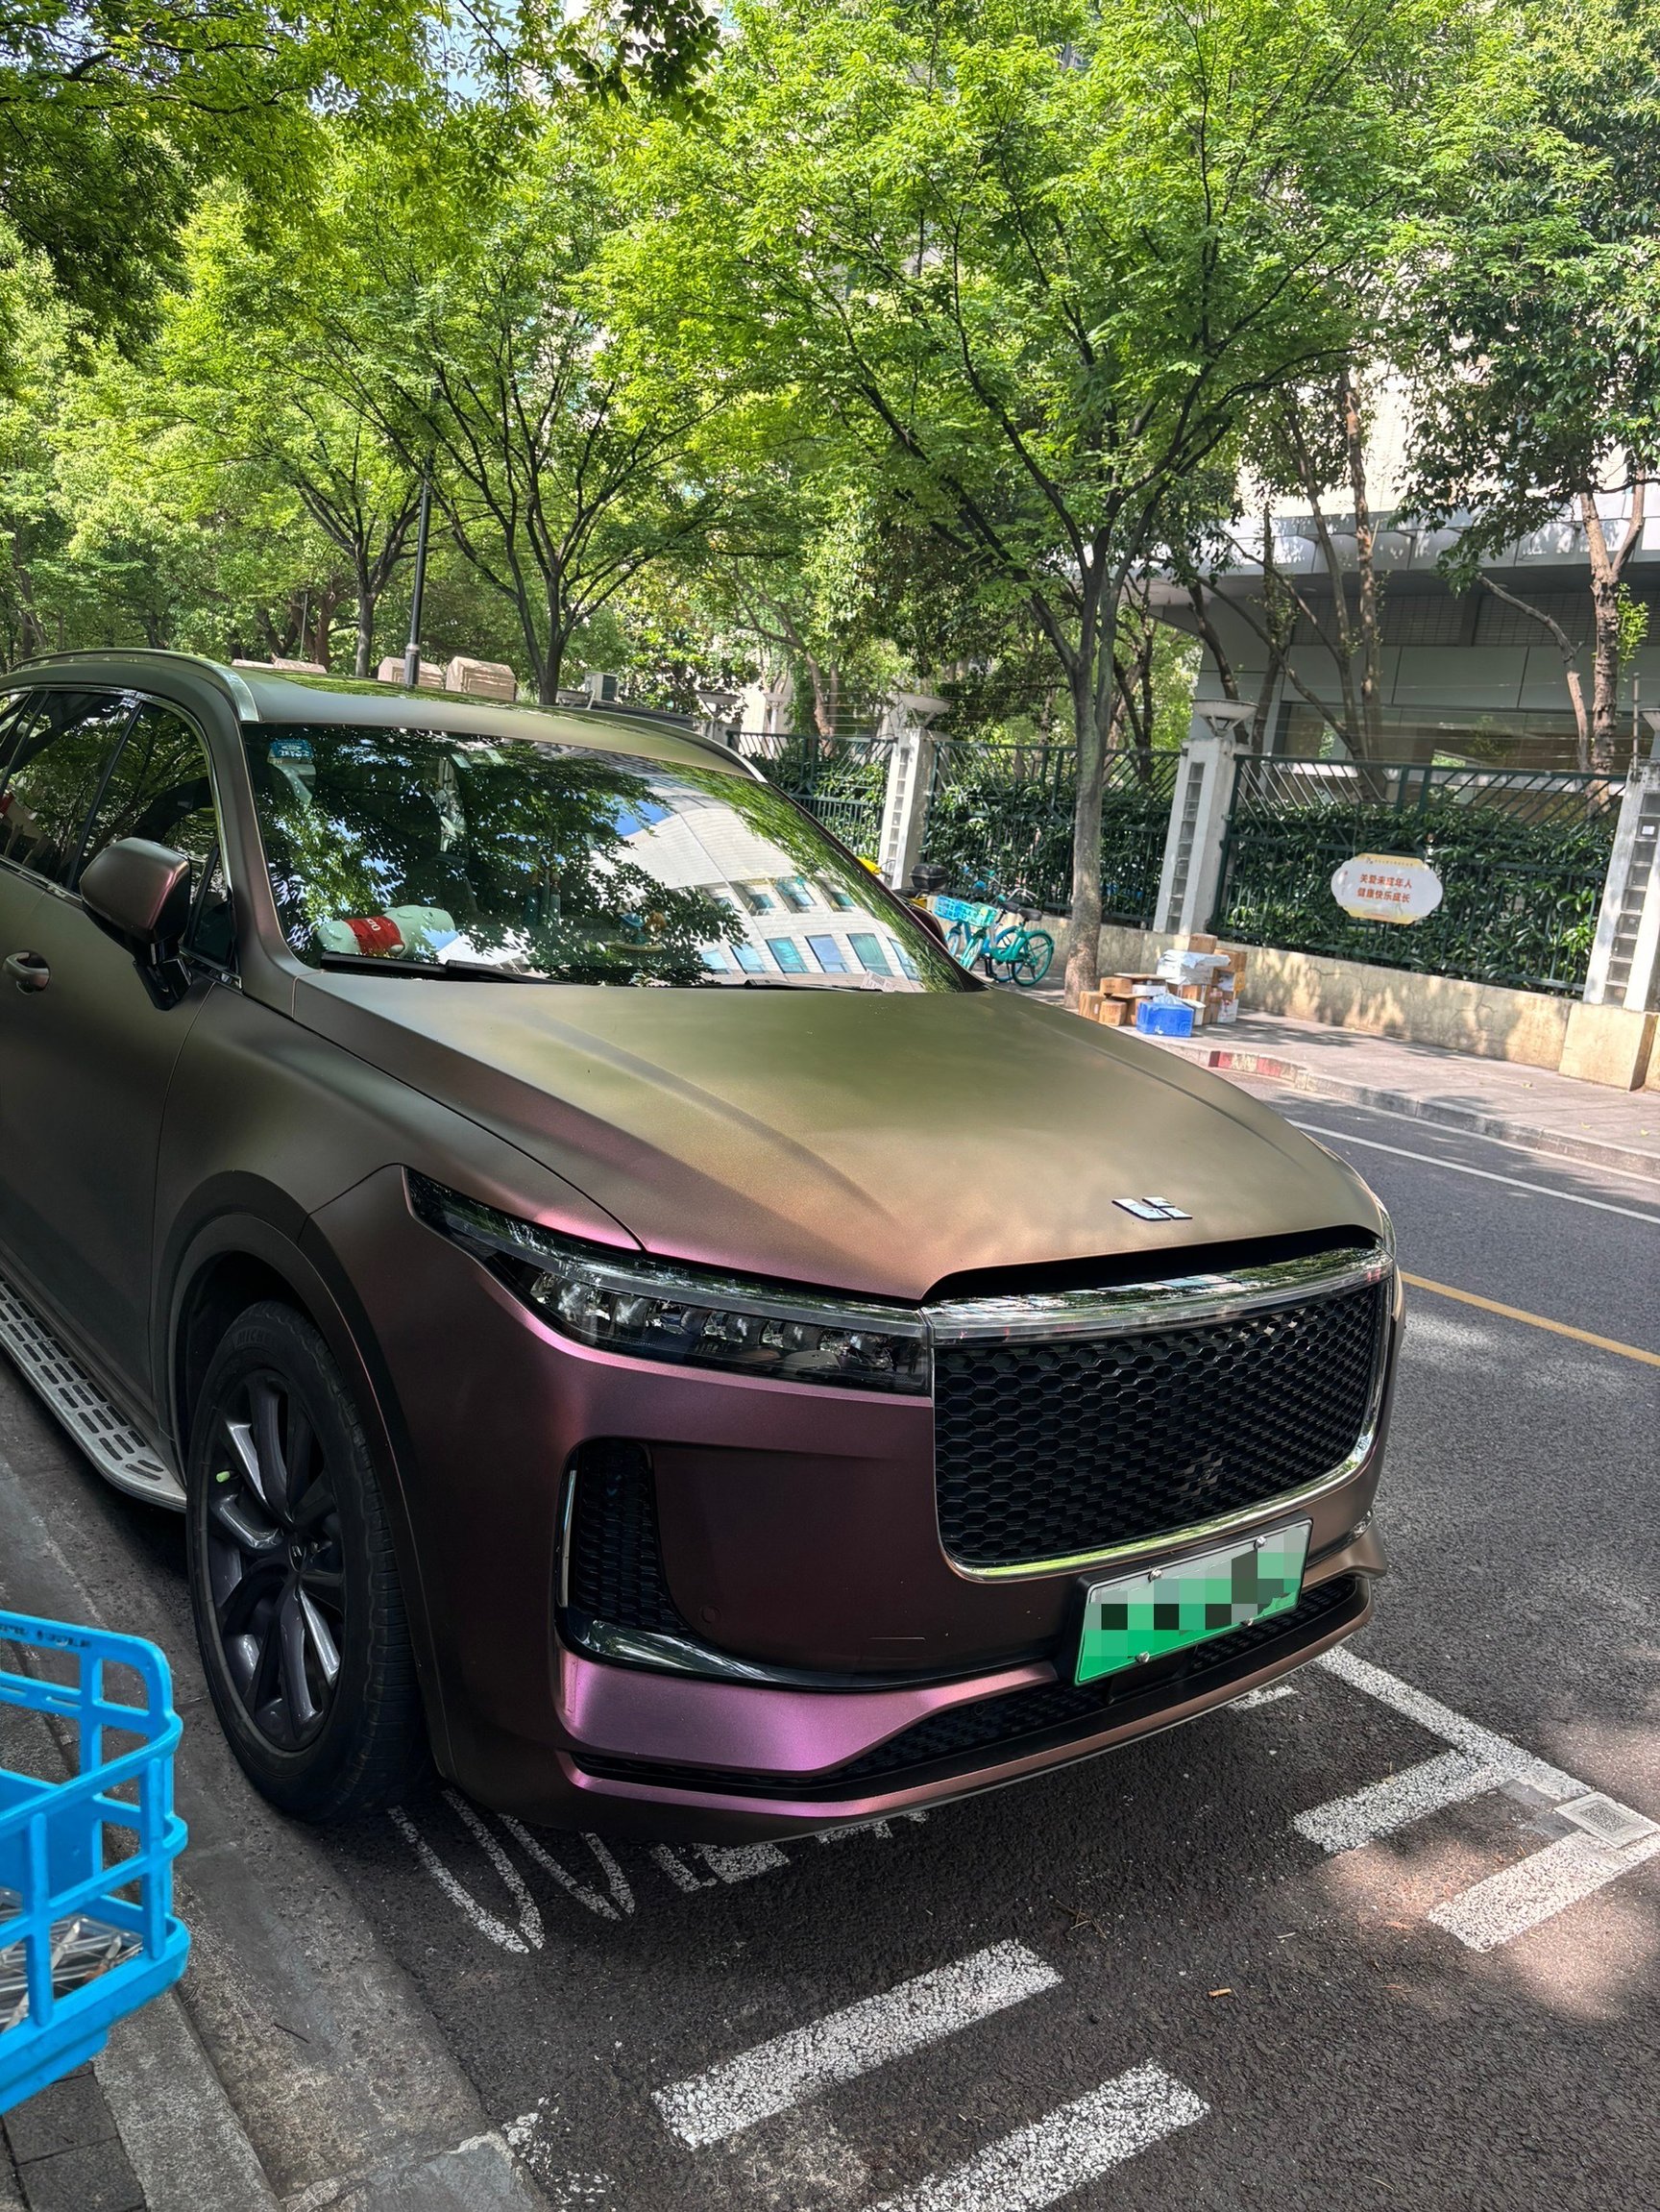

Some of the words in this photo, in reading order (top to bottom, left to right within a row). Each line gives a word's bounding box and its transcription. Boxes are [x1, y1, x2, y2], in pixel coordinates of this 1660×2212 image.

[1359, 873, 1412, 888] 关爱未成年人
[1357, 888, 1410, 902] 健康快乐成长
